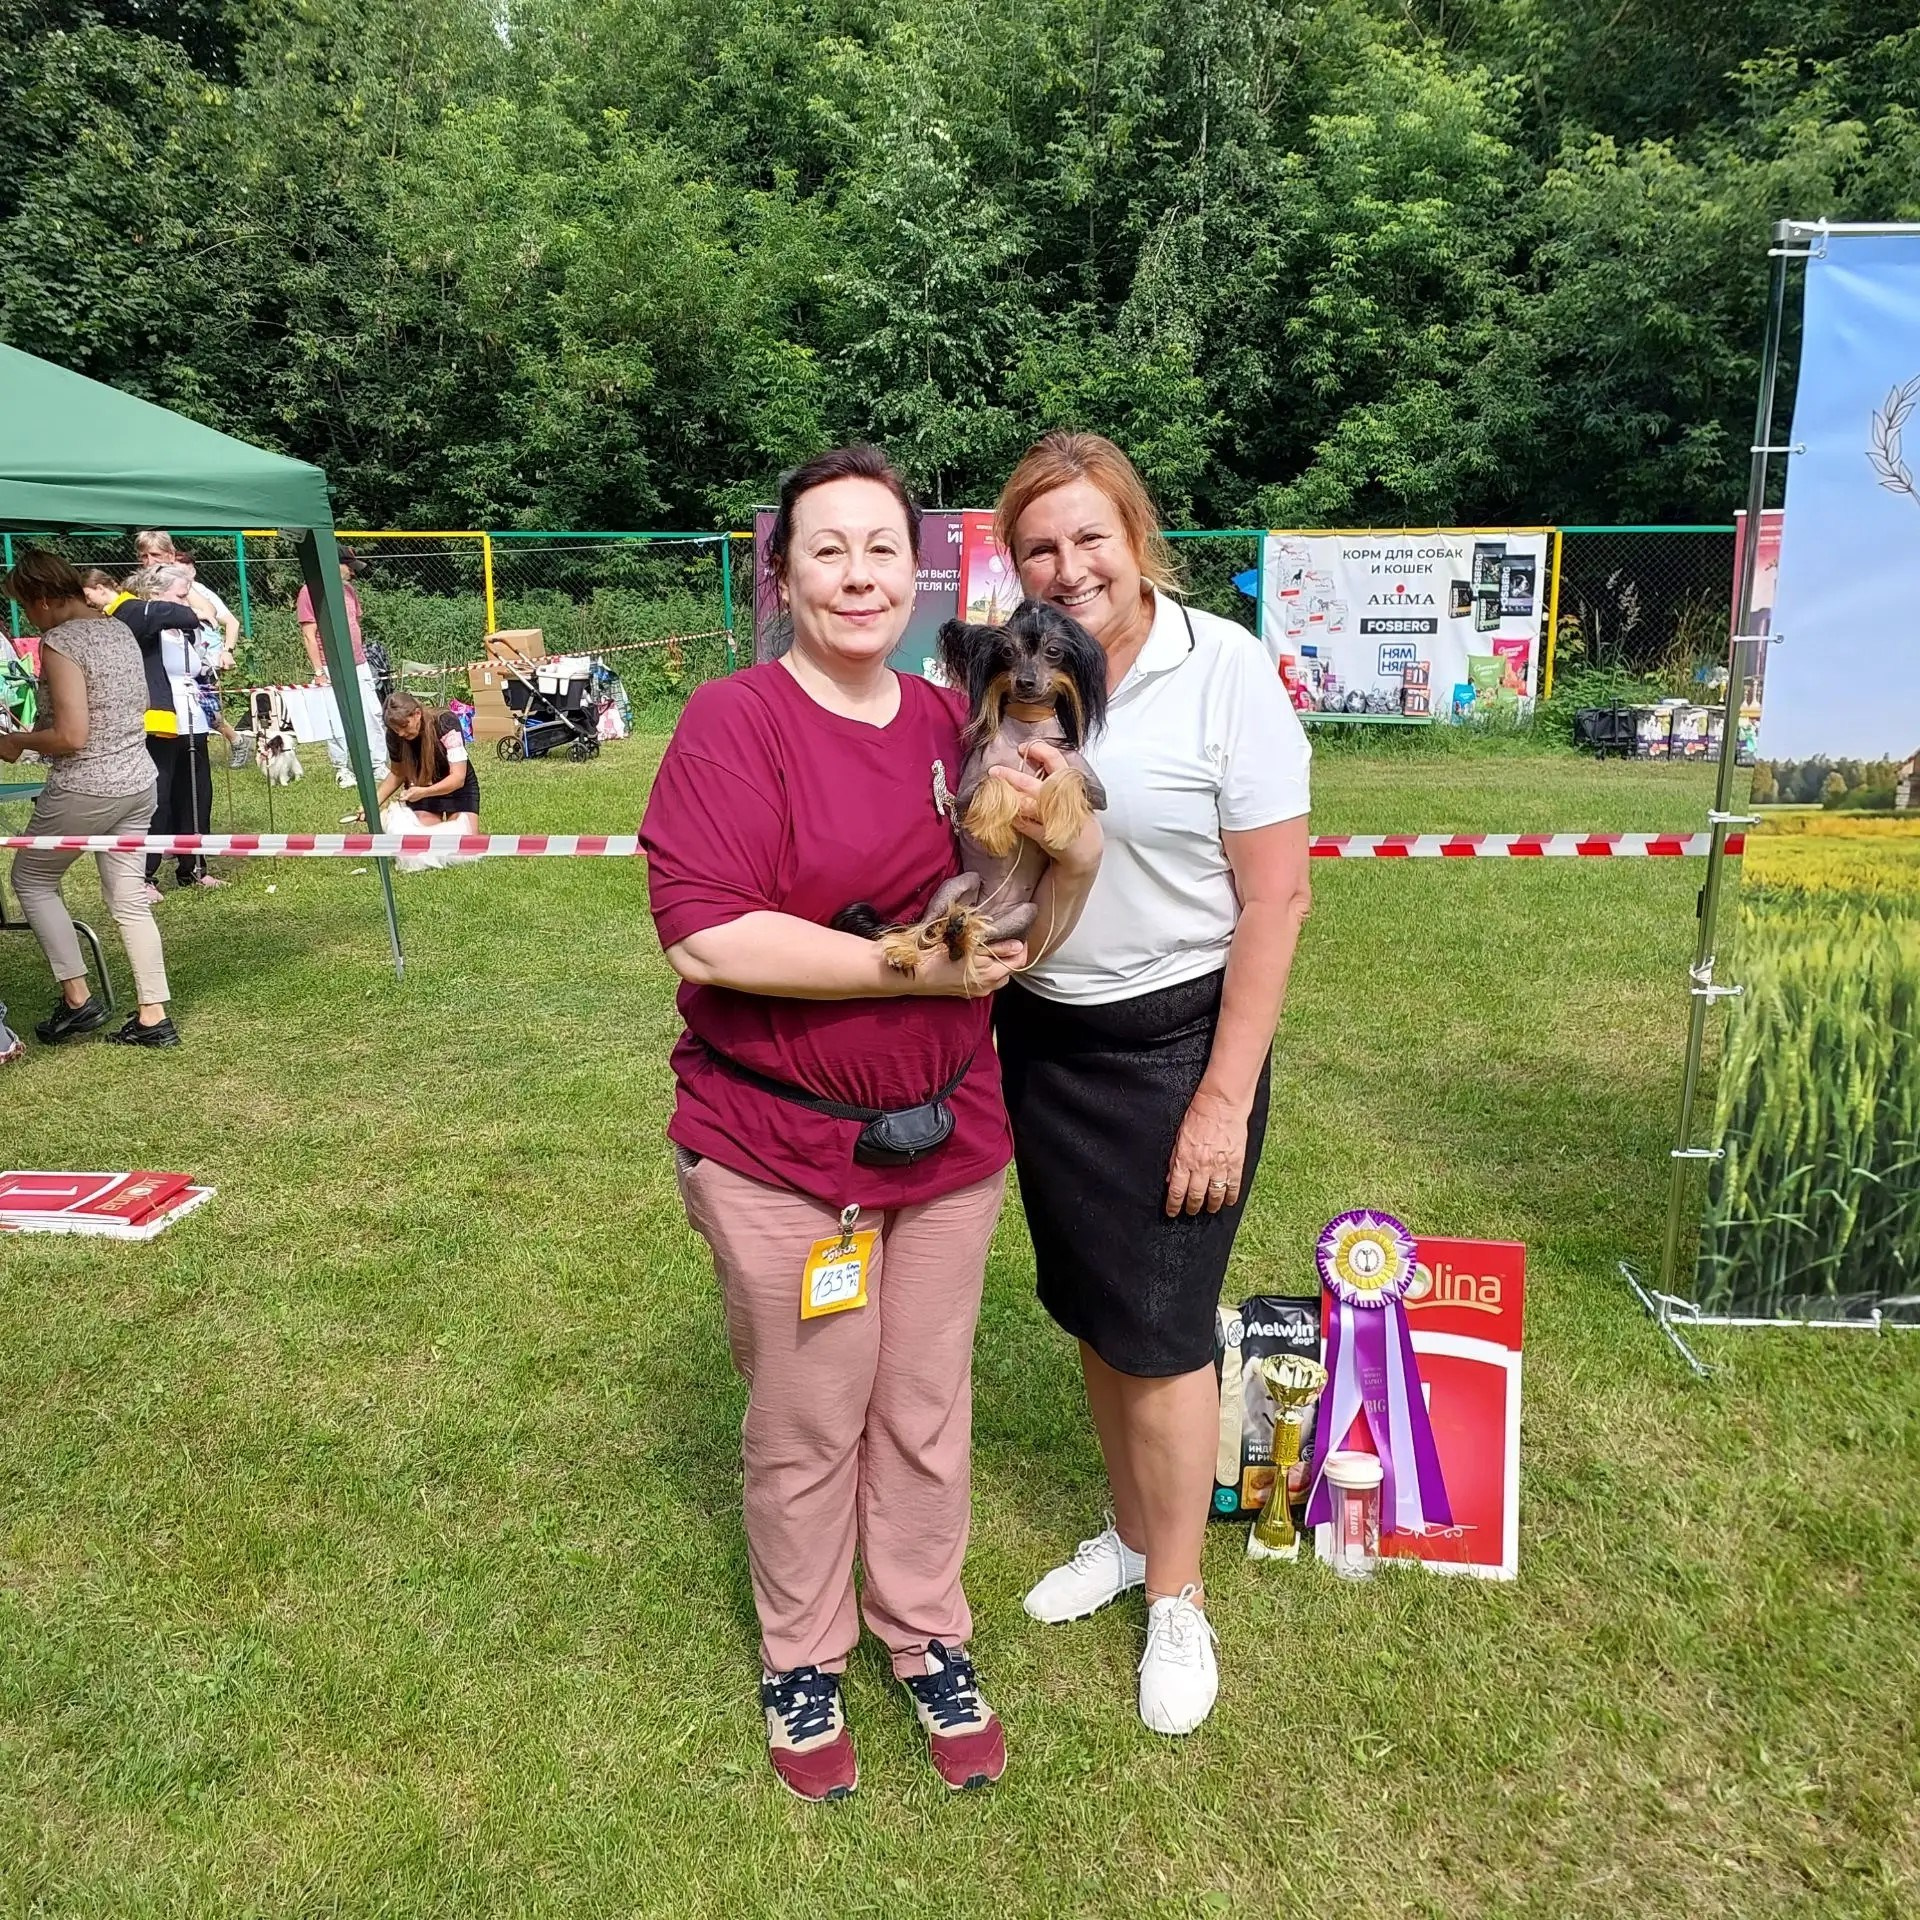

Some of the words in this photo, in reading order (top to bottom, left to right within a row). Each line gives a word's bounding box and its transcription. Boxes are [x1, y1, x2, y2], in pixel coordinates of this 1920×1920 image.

[1343, 550, 1381, 559] КОРМ
[1385, 550, 1413, 560] ДЛЯ
[1417, 549, 1463, 558] СОБАК
[915, 569, 929, 579] АЯ
[1371, 564, 1380, 573] И
[1384, 564, 1433, 573] КОШЕК
[1367, 593, 1435, 605] AKIMA
[1367, 621, 1431, 632] FOSBERG
[1382, 648, 1413, 659] НЯМ
[812, 1270, 843, 1300] 133
[1246, 1321, 1315, 1338] Melwin
[1292, 1336, 1315, 1346] dogs
